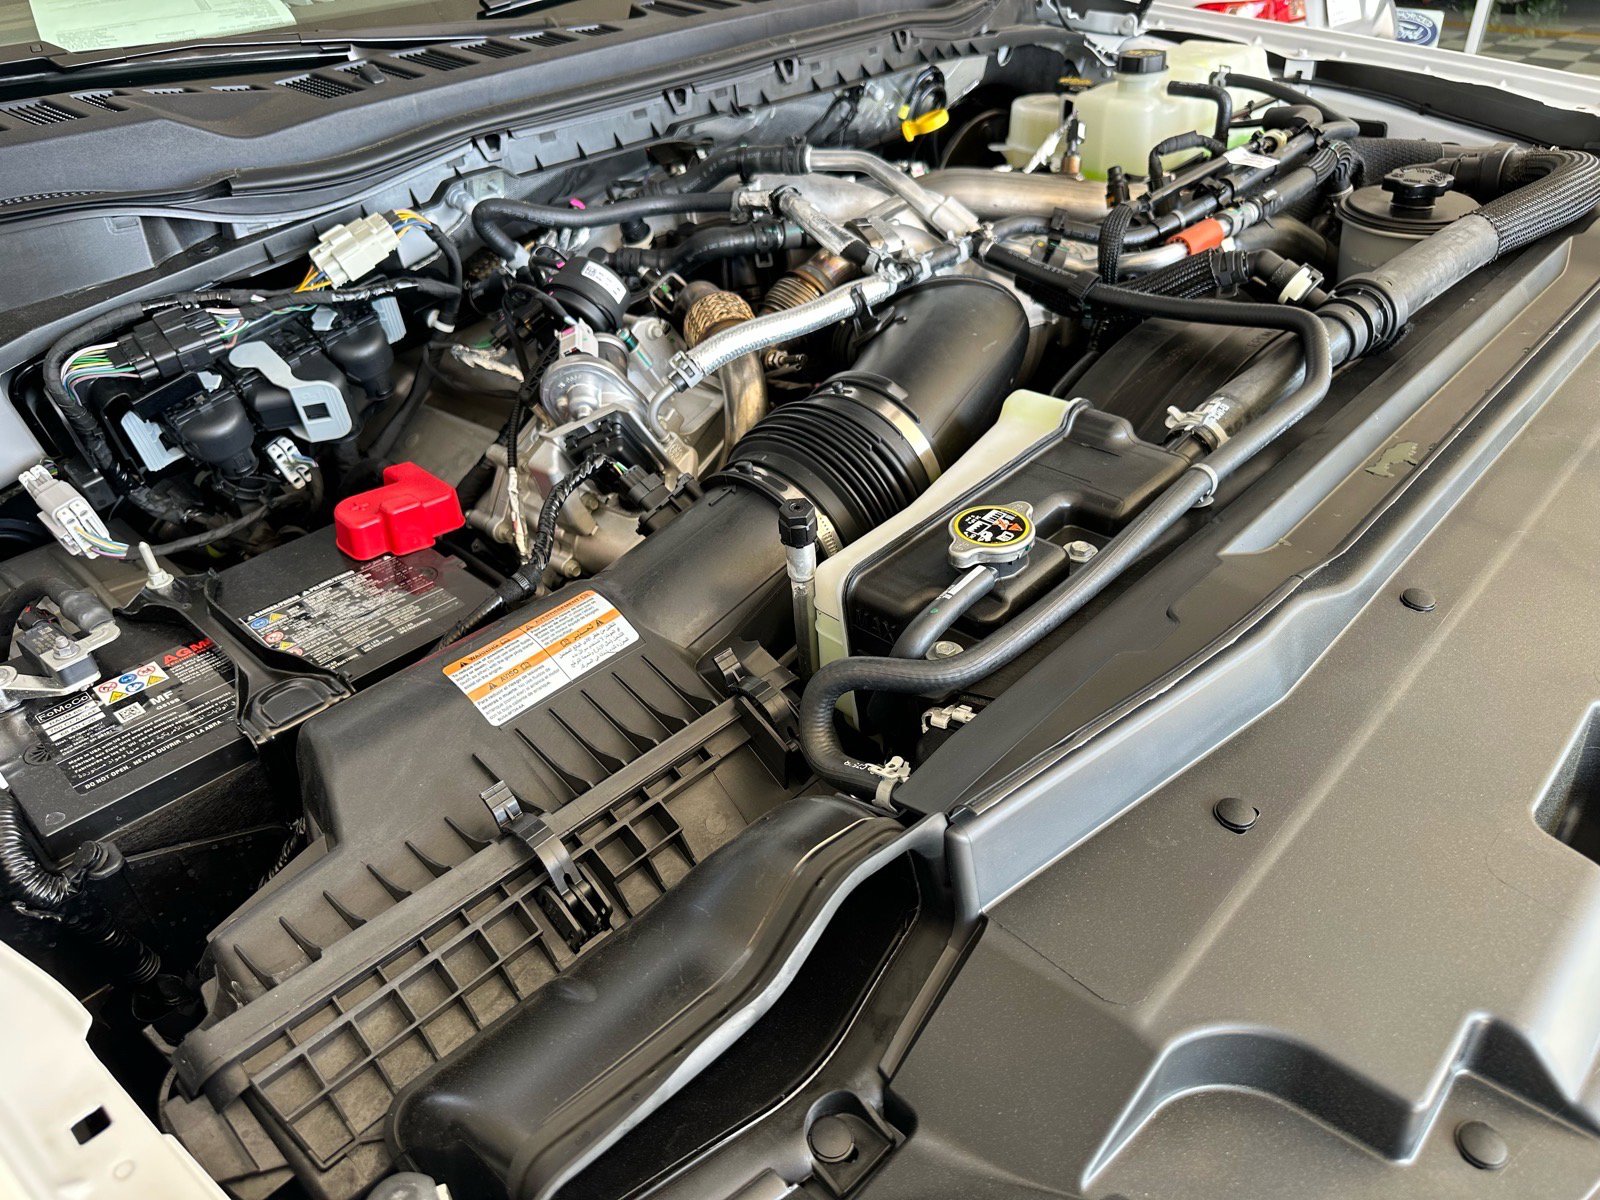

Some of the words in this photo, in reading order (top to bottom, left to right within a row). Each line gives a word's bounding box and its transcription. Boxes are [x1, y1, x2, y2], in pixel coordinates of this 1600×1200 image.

[161, 636, 211, 664] AGM
[498, 667, 520, 682] AVISO
[36, 693, 89, 721] FoMoCo
[148, 688, 174, 706] MF
[84, 781, 96, 790] DO
[95, 773, 110, 784] NOT
[109, 763, 131, 777] OPEN.
[132, 757, 143, 766] NE
[142, 750, 156, 761] PAS
[155, 737, 184, 754] OUVRIR.
[184, 731, 196, 740] NO
[194, 726, 205, 735] LA
